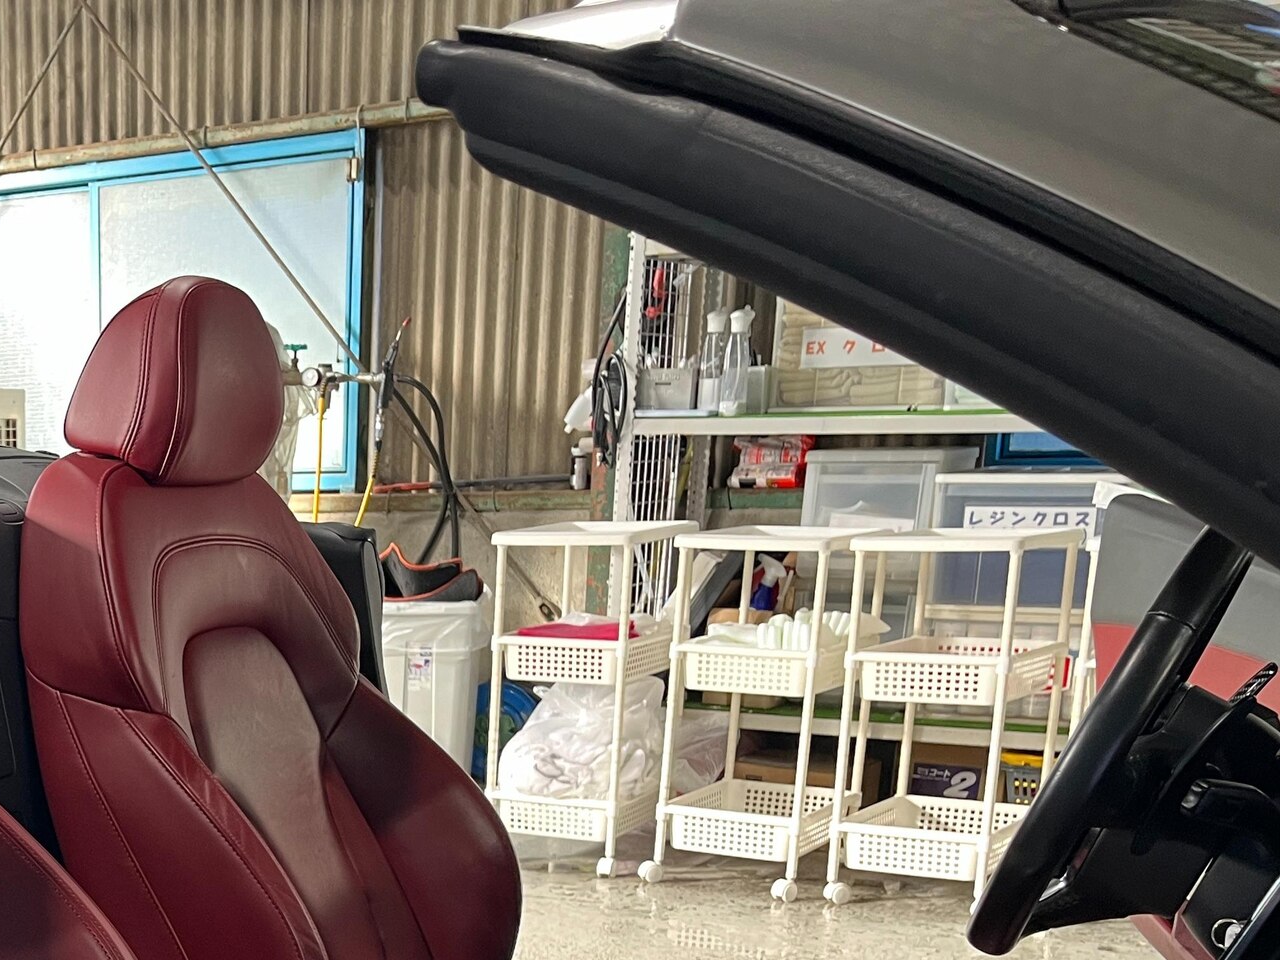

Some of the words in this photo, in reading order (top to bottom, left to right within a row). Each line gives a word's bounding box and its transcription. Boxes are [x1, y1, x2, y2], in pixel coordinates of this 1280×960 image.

[805, 341, 827, 355] EX
[969, 510, 1090, 527] レジンクロス
[943, 771, 977, 798] 2
